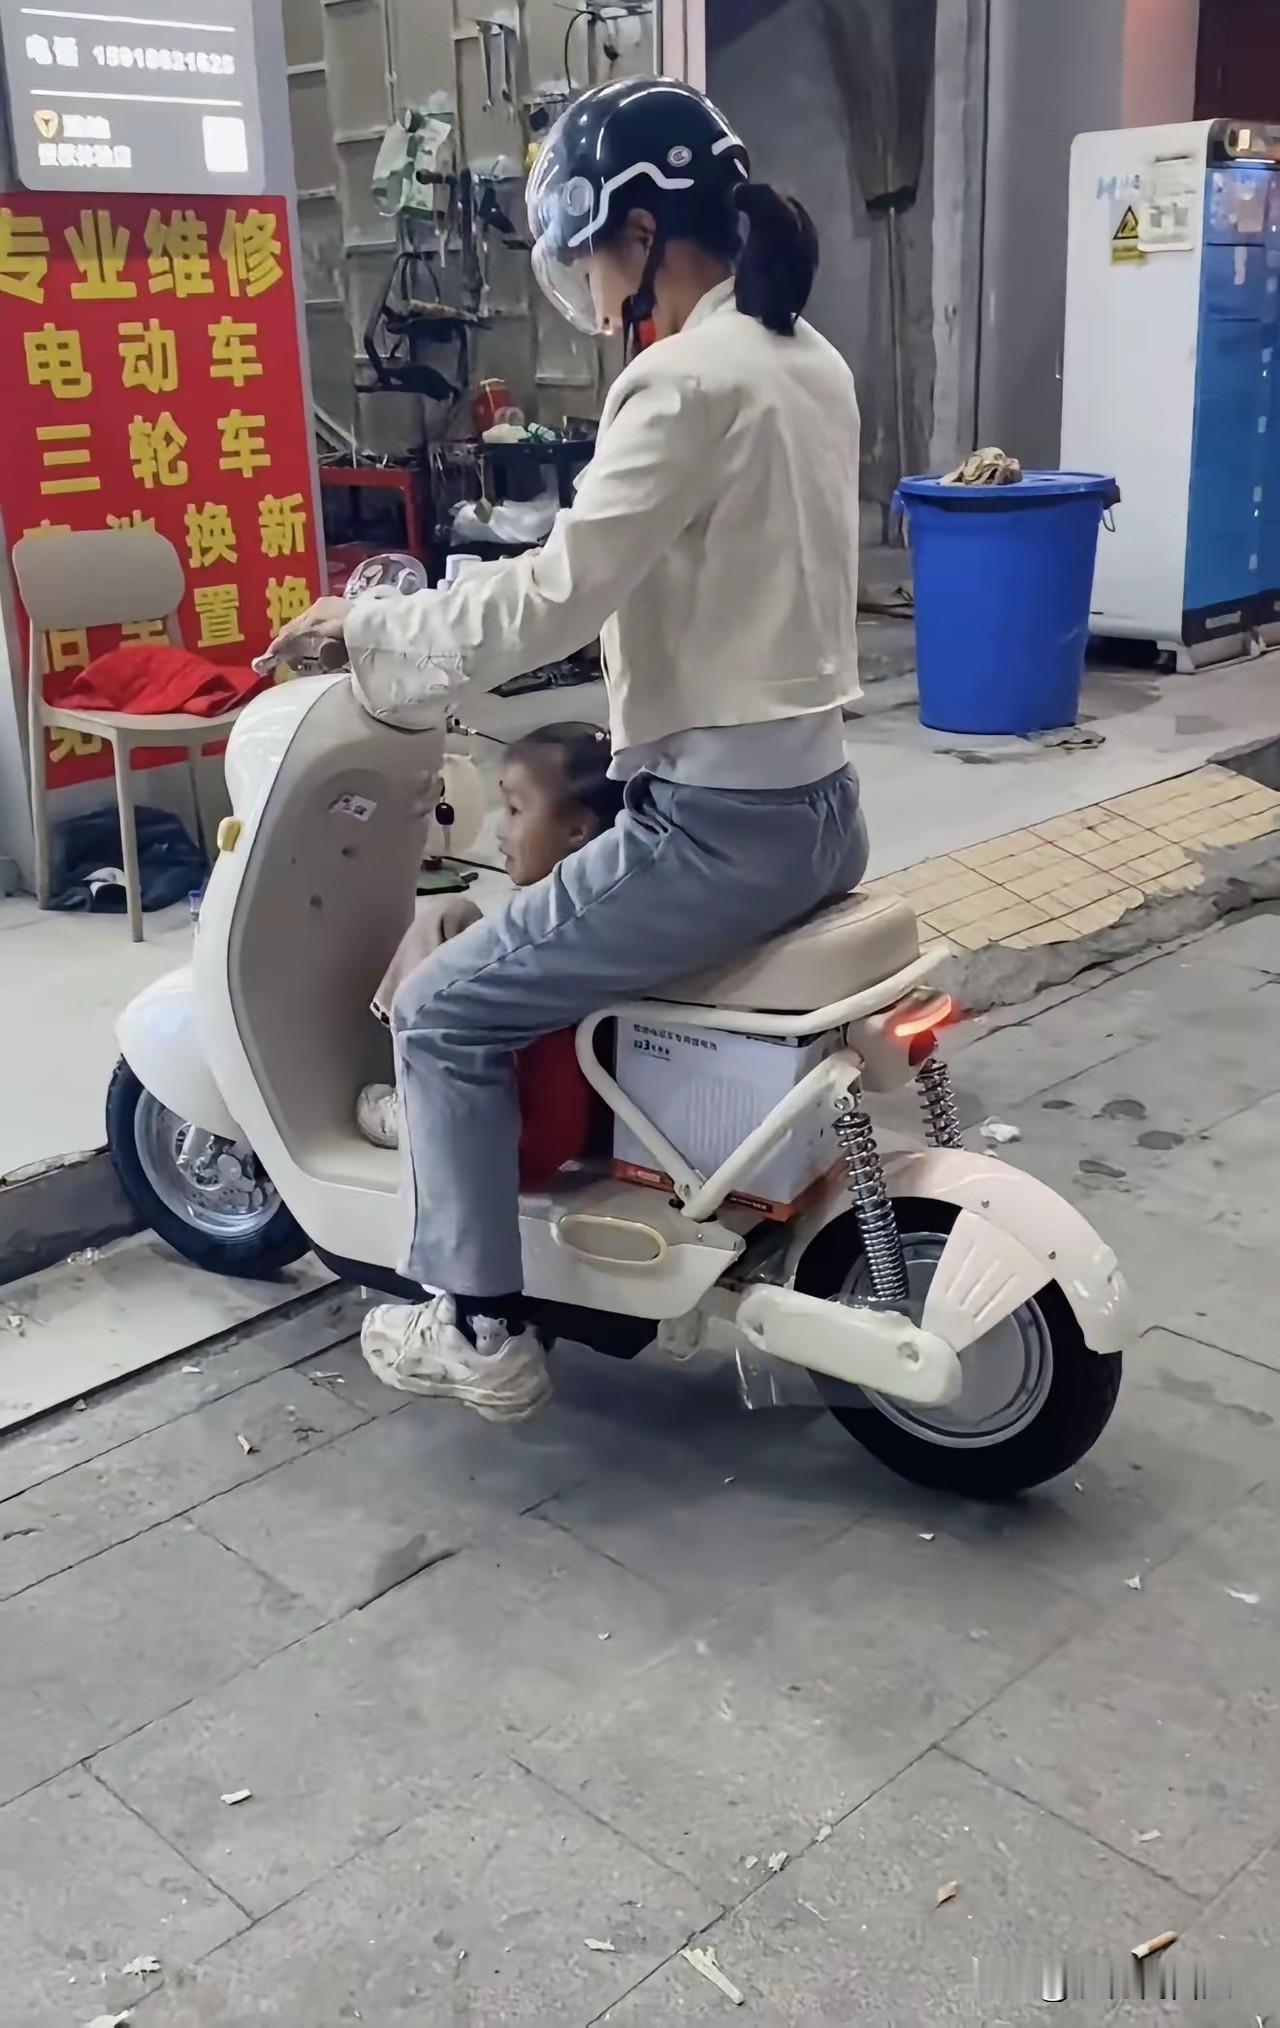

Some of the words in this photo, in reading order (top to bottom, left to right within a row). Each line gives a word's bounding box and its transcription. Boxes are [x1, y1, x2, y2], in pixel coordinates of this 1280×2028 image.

[0, 208, 284, 305] 专业维修
[24, 315, 263, 399] 电动车
[36, 409, 271, 494] 三轮车
[23, 493, 307, 569] 换新
